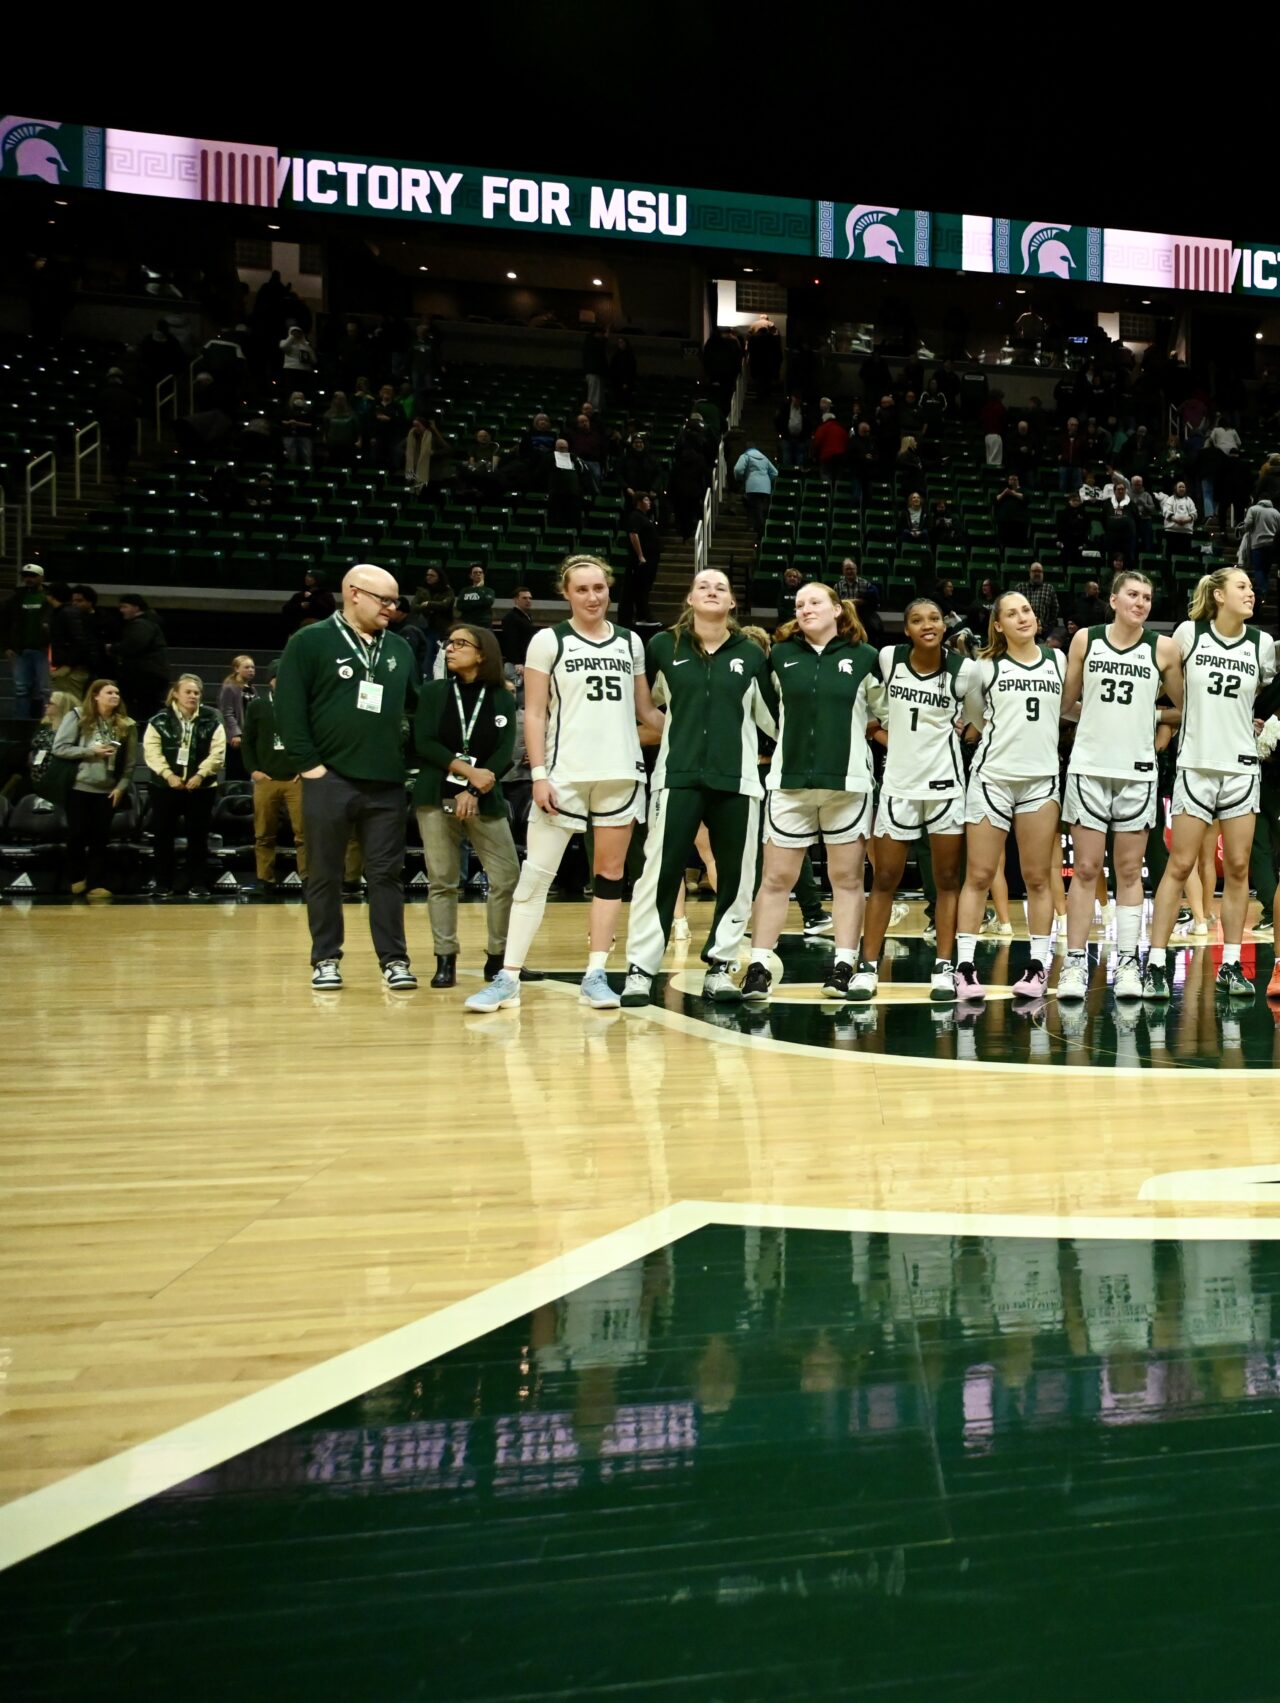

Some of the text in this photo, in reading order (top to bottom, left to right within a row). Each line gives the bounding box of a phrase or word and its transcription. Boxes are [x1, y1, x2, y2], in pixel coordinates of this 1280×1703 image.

[483, 176, 571, 226] FOR
[589, 187, 687, 236] MSU
[565, 658, 631, 674] SPARTANS
[1089, 660, 1151, 679] SPARTANS
[1195, 654, 1255, 677] SPARTANS
[586, 675, 622, 702] 35
[889, 684, 950, 709] SPARTANS
[998, 679, 1060, 696] SPARTANS
[1100, 679, 1133, 705] 33
[1207, 671, 1241, 699] 32
[909, 707, 918, 731] 1
[1026, 697, 1039, 721] 9
